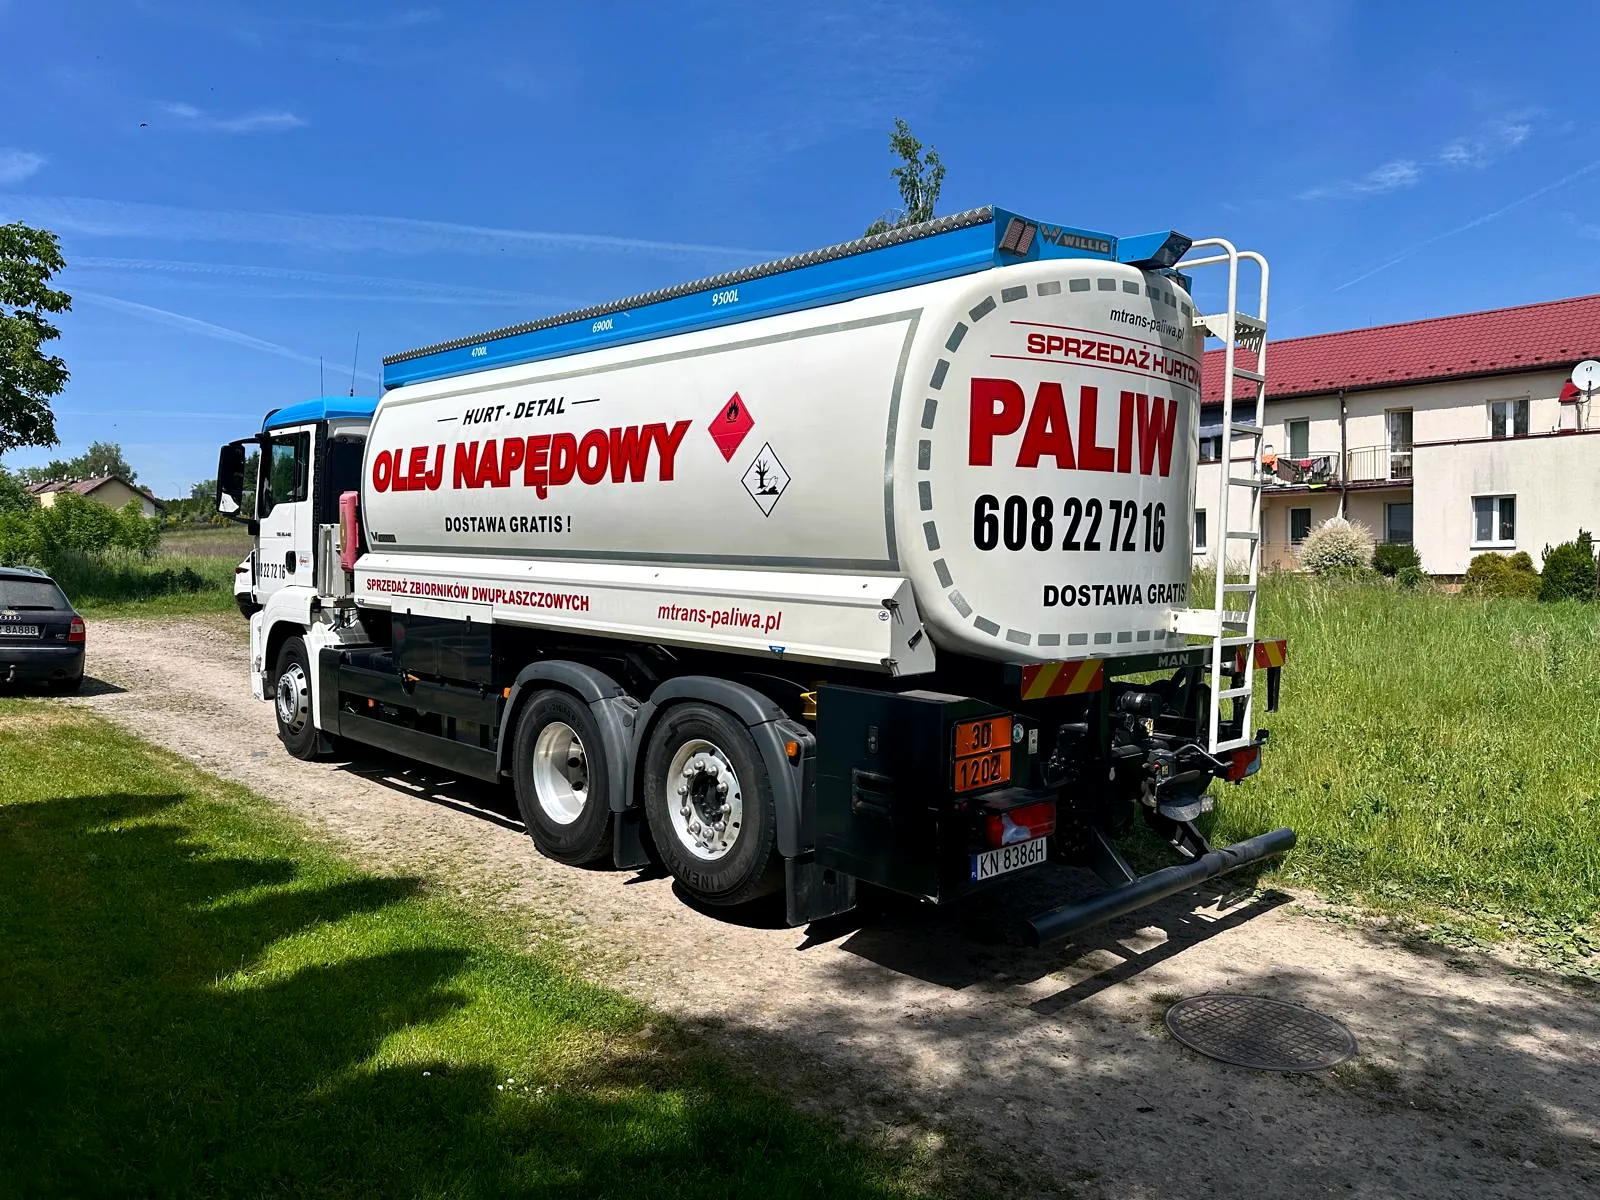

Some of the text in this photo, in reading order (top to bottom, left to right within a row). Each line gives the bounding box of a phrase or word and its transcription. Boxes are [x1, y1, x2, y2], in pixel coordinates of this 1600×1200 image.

[1064, 235, 1109, 253] WILLIG
[712, 289, 739, 307] 9500L
[592, 318, 613, 334] 6900L
[1110, 307, 1185, 343] mtrans-paliwa.pl
[471, 346, 488, 358] 4700L
[1027, 332, 1150, 371] SPRZEDAŻ
[463, 405, 505, 426] HURT
[514, 397, 566, 421] DETAL
[969, 377, 1178, 478] PALIW
[372, 419, 693, 500] OLEJ NAPĘDOWY
[445, 516, 507, 533] DOSTAWA
[510, 515, 564, 533] GRATIS
[973, 494, 1166, 554] 608 22 72 16
[366, 578, 590, 613] SPRZEDAŻ ZBIORNIKÓW DWUPŁASZCZOWYCH
[1043, 585, 1143, 607] DOSTAWA
[5, 625, 36, 635] 8A888
[658, 602, 783, 633] mtrans-paliwa.pl
[1158, 653, 1190, 669] MAN
[971, 721, 992, 751] 30
[960, 757, 1002, 788] 1202
[980, 851, 999, 878] KN
[1003, 839, 1044, 870] 8386H
